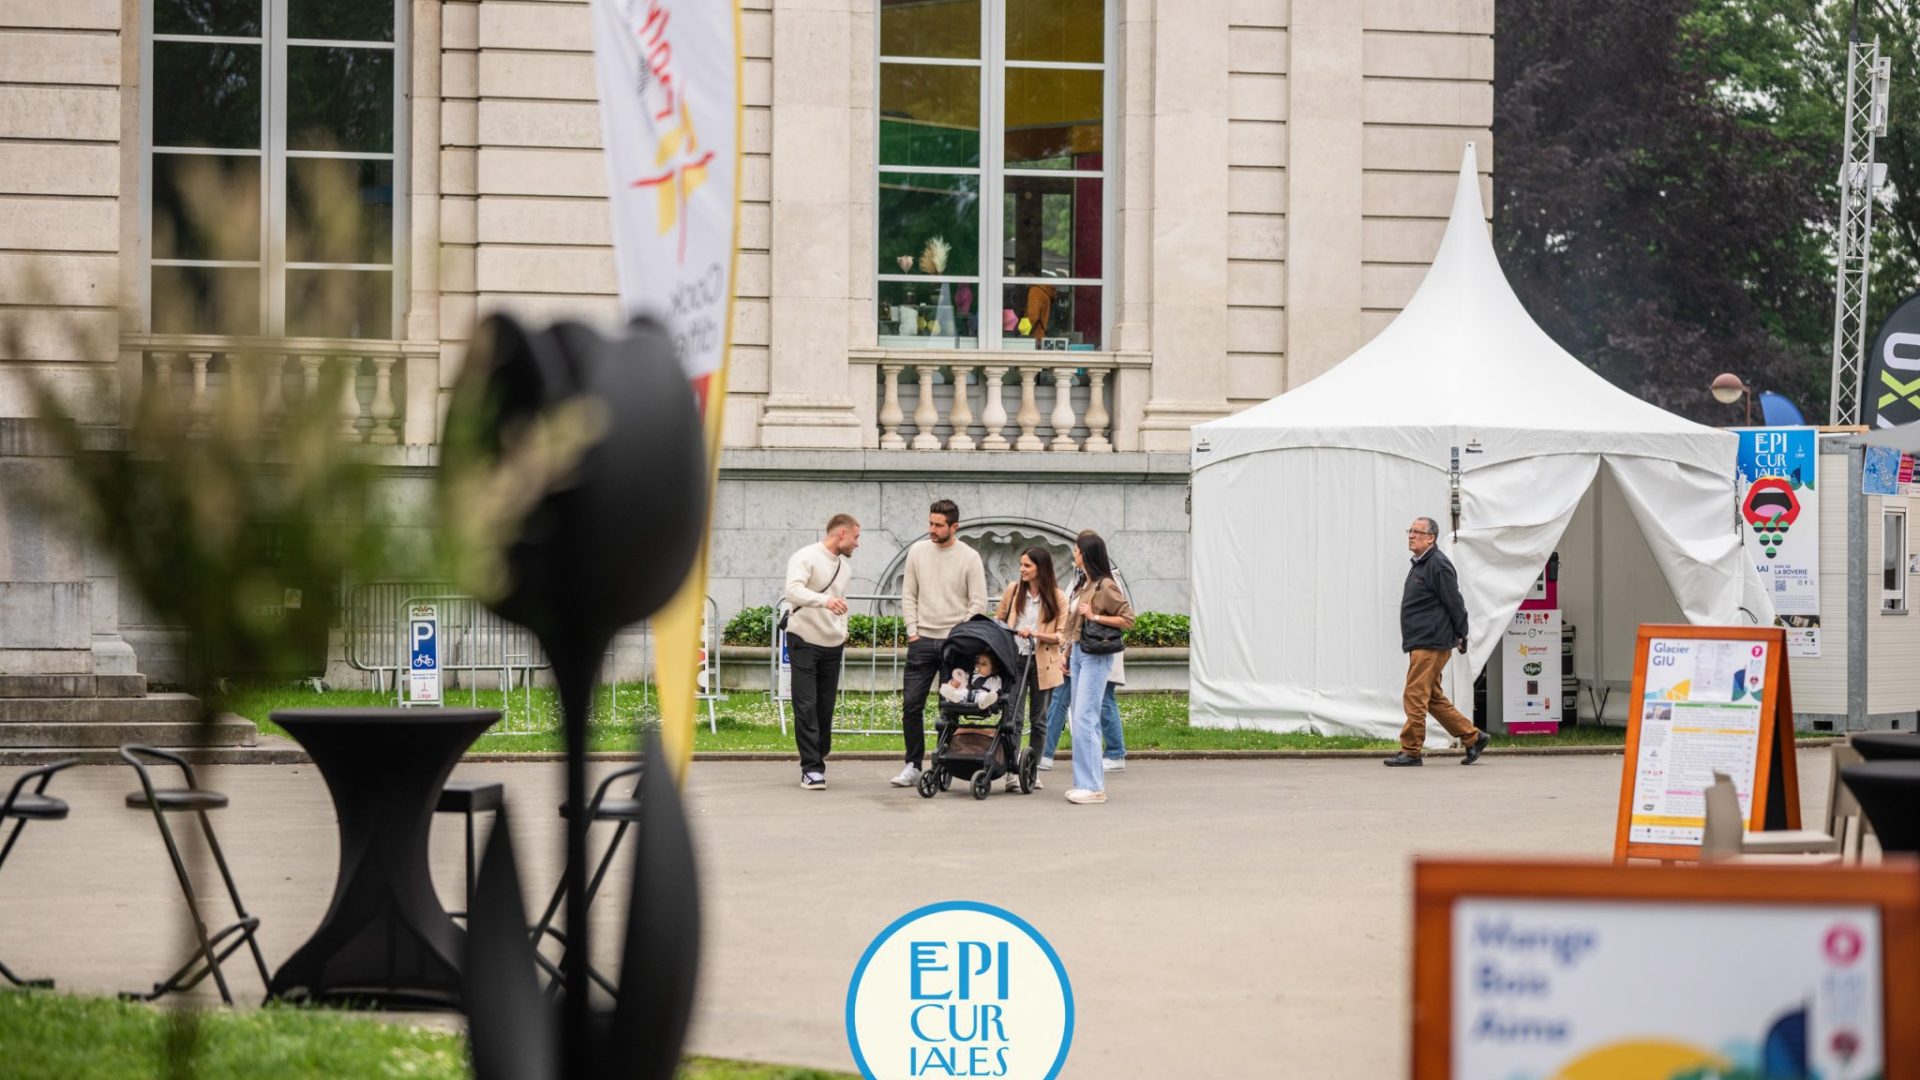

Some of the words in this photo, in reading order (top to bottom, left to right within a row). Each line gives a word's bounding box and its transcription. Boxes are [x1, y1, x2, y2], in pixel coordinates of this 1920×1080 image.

[1755, 432, 1787, 453] EPI
[1755, 453, 1787, 467] CUR
[413, 622, 434, 651] P
[1653, 642, 1690, 654] Glacier
[1652, 655, 1675, 667] GIU
